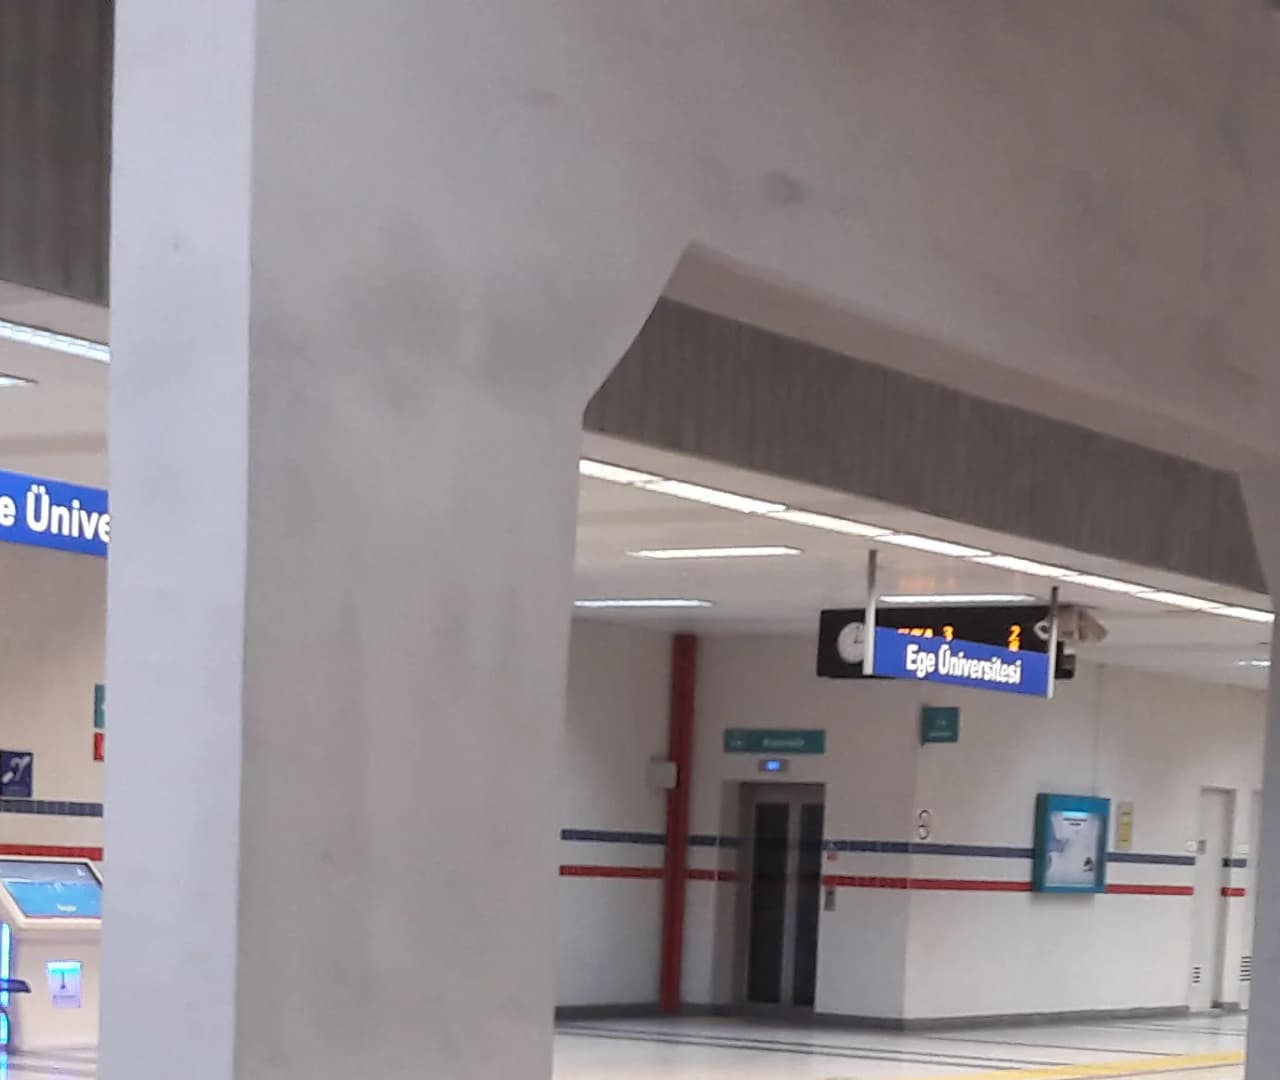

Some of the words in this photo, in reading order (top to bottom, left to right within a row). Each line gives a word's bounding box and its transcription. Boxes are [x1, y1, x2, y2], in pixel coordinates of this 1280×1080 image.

[26, 484, 111, 543] Ünive
[906, 643, 936, 679] Ege
[937, 643, 1022, 684] Üniversitesi
